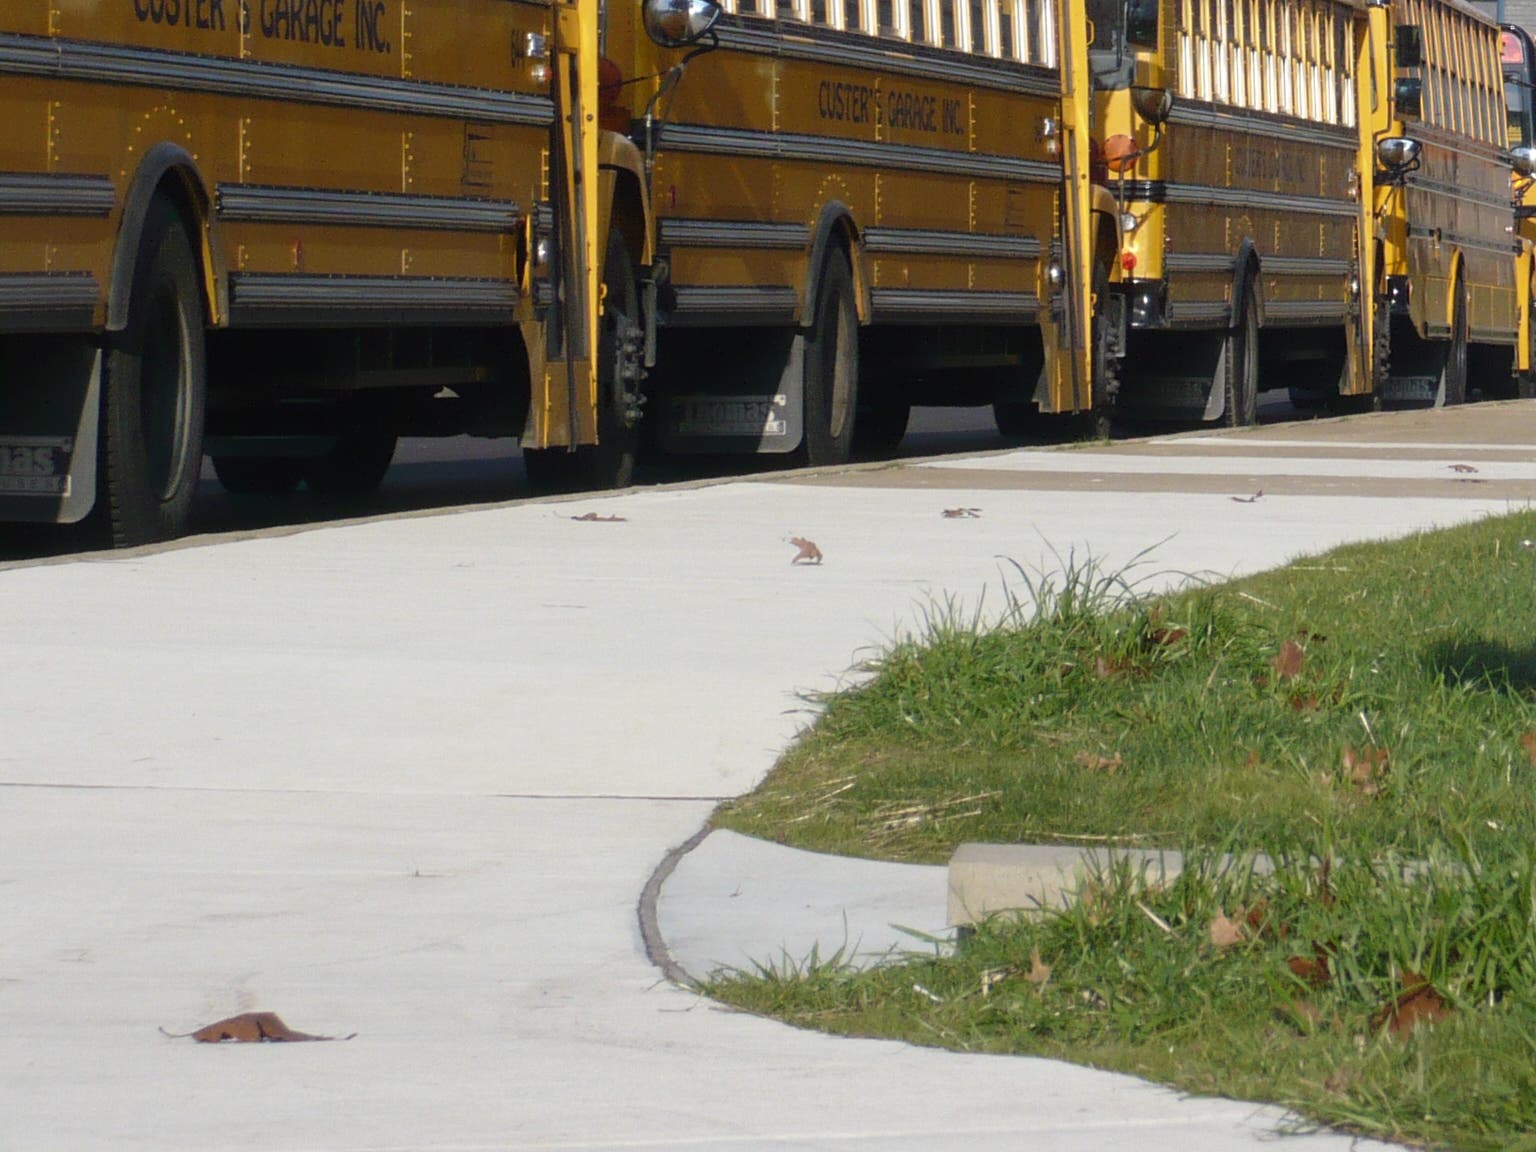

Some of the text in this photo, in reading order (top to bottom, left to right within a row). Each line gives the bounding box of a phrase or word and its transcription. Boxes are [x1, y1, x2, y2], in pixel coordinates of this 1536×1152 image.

[818, 79, 965, 136] CUSTER'S GARAGE INC.
